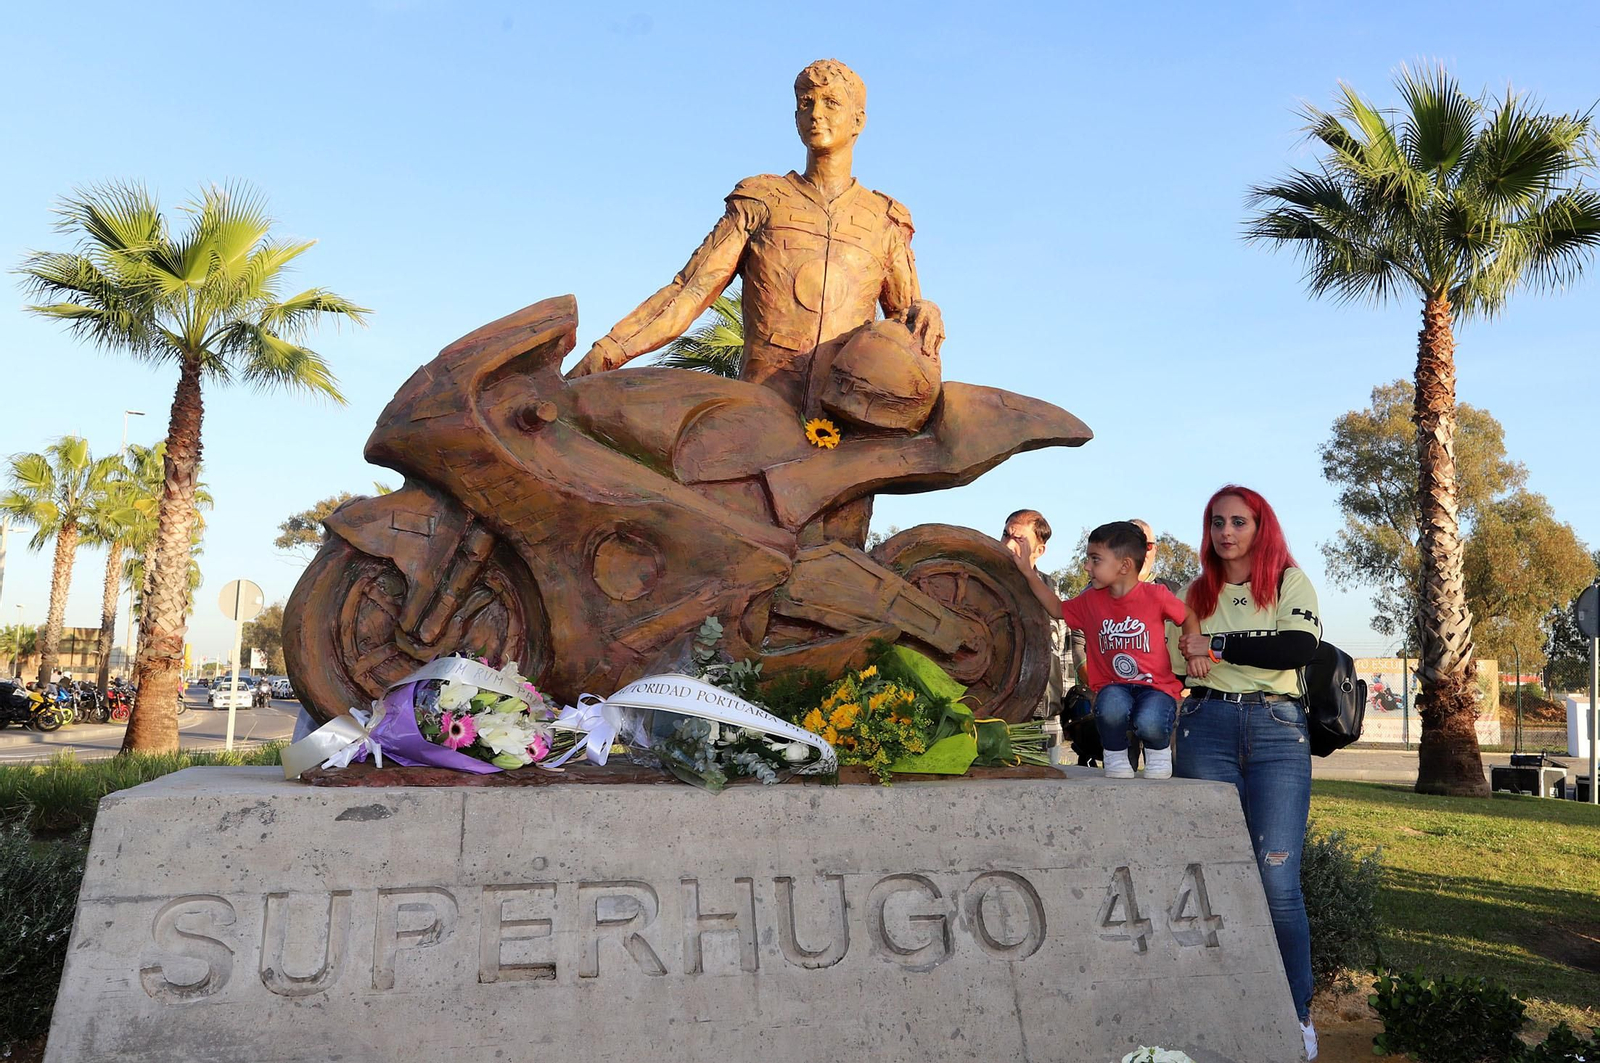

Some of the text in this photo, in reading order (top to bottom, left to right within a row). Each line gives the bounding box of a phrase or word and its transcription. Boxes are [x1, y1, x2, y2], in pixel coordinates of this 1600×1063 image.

[1100, 615, 1146, 641] Skate
[1098, 630, 1151, 654] CHAMPION
[474, 667, 504, 686] RUM
[696, 690, 778, 723] PORTUARIA
[139, 863, 1226, 1003] SUPERHUGO 44
